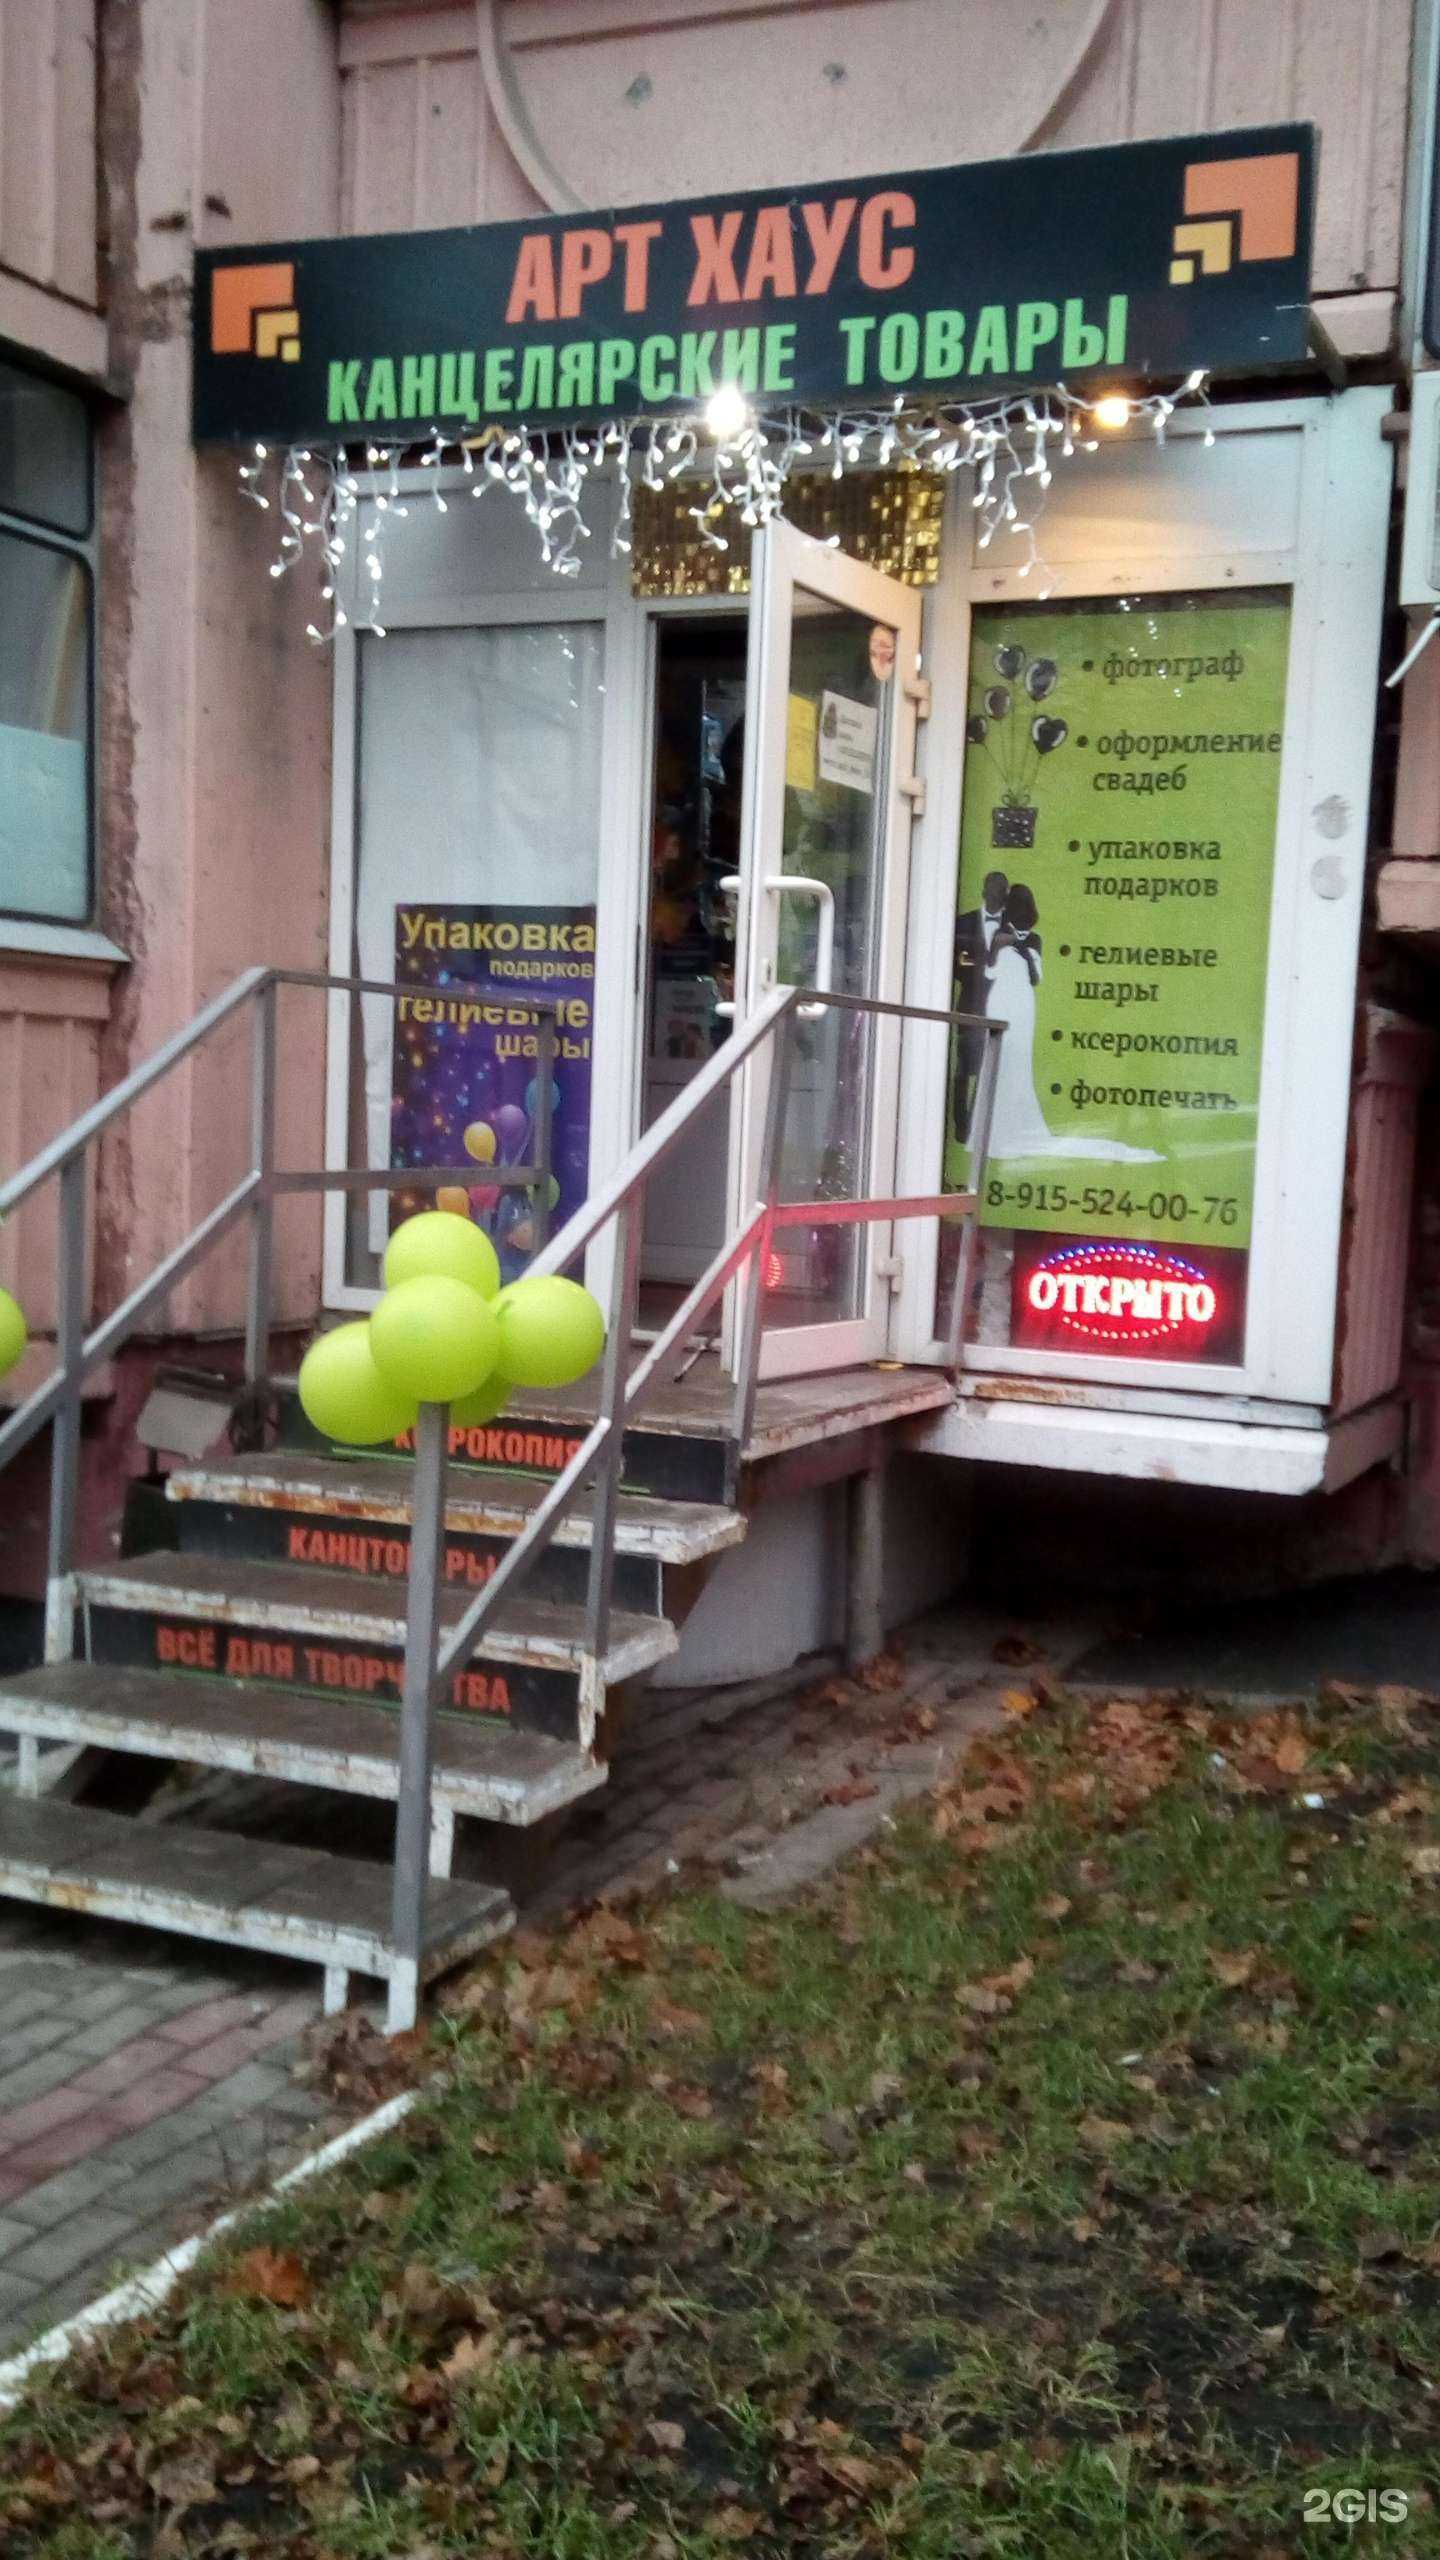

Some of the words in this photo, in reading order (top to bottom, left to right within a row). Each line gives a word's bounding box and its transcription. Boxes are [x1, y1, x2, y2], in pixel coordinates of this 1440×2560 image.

[505, 220, 663, 323] АРТ
[687, 191, 917, 307] ХАУС
[327, 323, 798, 423] КАНЦЕЛЯРСКИЕ
[839, 294, 1129, 386] ТОВАРЫ
[1102, 650, 1245, 684] фотограф
[1096, 729, 1282, 761] оформление
[1092, 764, 1188, 795] свадеб
[1087, 840, 1222, 865] упаковка
[1083, 875, 1219, 902] подарков
[400, 912, 596, 952] Упаковка
[489, 959, 595, 982] подарков
[1078, 945, 1218, 968] гелиевые
[1074, 979, 1159, 1007] шары
[1070, 1030, 1239, 1057] ксерокопия
[1069, 1079, 1238, 1111] фотопечать
[986, 1181, 1238, 1225] 8-915-524-00-76
[1028, 1271, 1216, 1322] ОТКРЫТО
[289, 1525, 501, 1585] КАНЦТОРЫ
[157, 1624, 216, 1669] ВСЁ
[224, 1635, 294, 1679] ДЛЯ
[302, 1647, 511, 1715] ТВОРЧТВА
